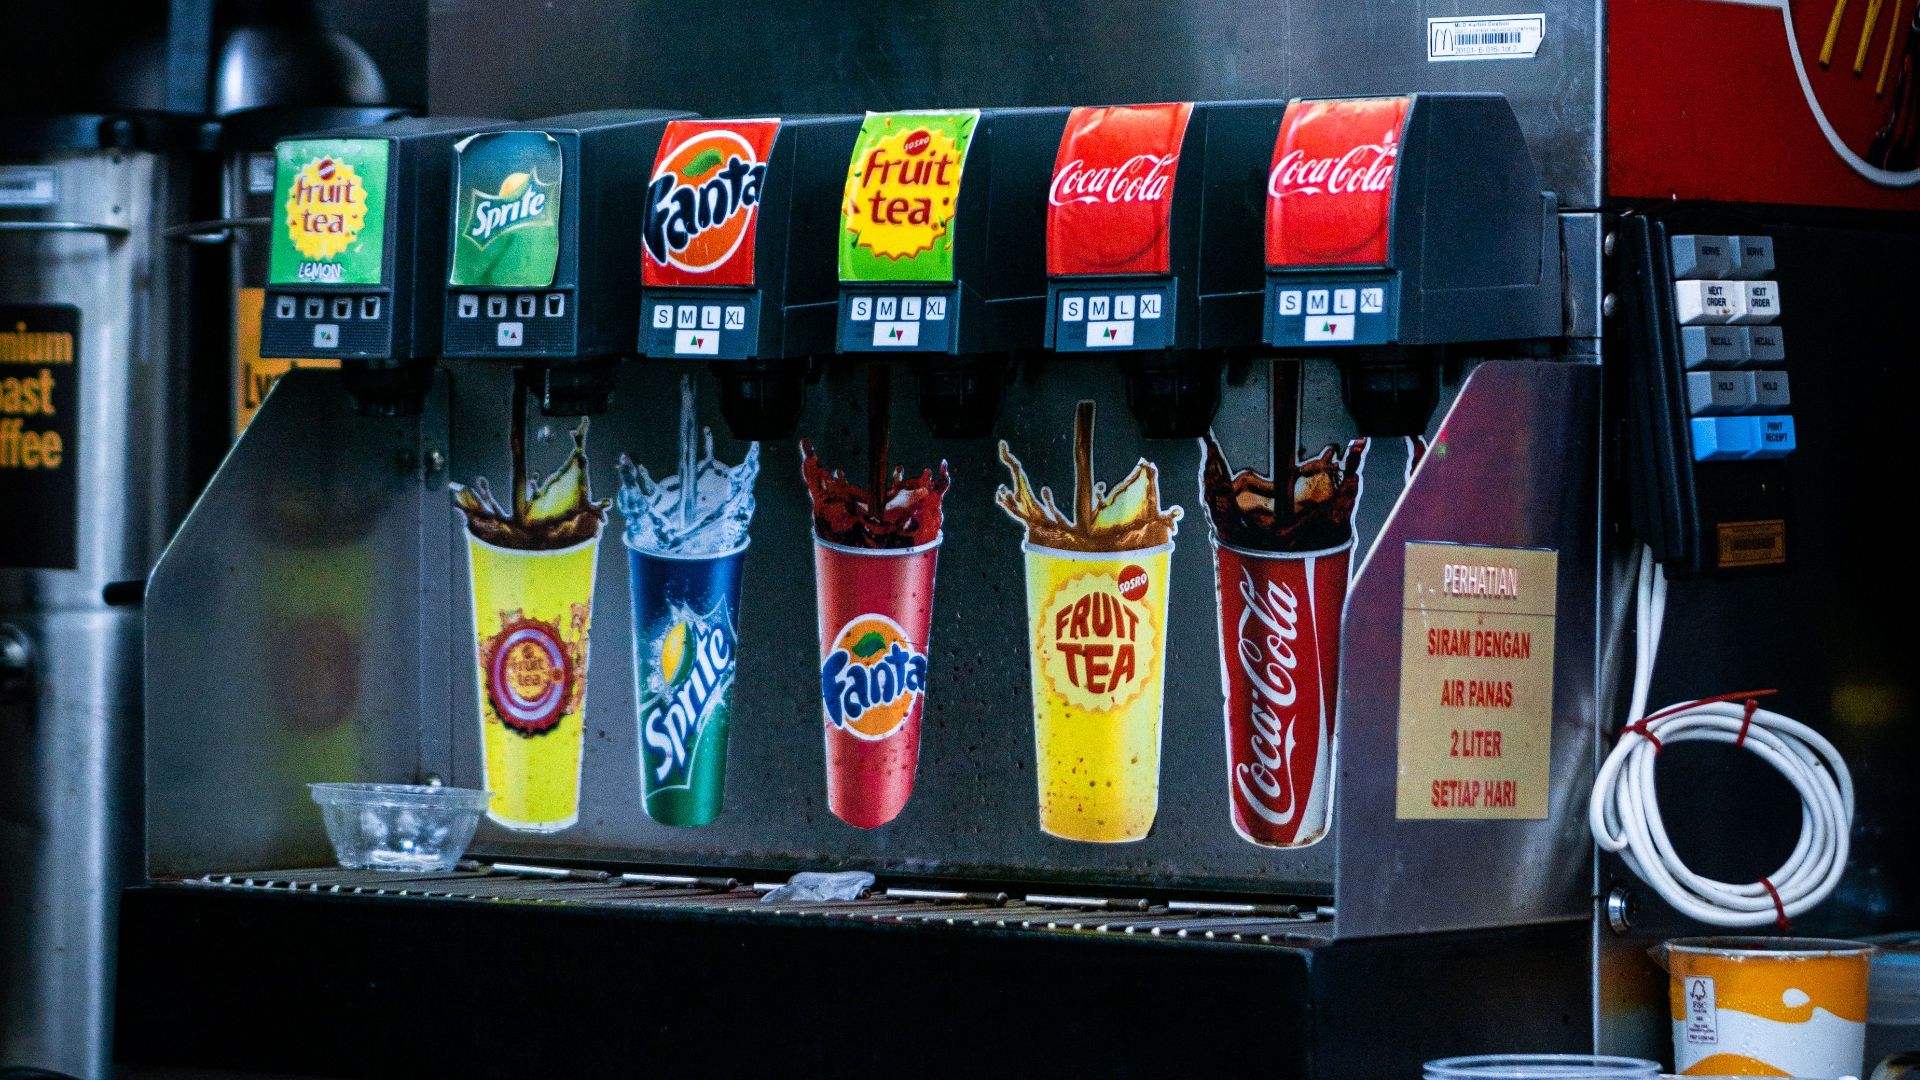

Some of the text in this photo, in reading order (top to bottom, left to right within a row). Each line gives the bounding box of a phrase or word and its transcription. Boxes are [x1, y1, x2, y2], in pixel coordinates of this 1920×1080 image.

[904, 136, 930, 151] SOSRO
[862, 149, 953, 188] fruit
[1049, 153, 1180, 207] Coca-Cola
[1267, 144, 1398, 199] Coca-Cola
[296, 175, 356, 206] fruit
[301, 209, 344, 233] tea
[471, 186, 546, 239] Sprite
[643, 156, 767, 264] Fanta
[868, 190, 933, 226] tea
[298, 261, 342, 281] LEMON
[1285, 292, 1382, 310] S M L XL
[1707, 297, 1726, 306] ORDER
[1708, 286, 1722, 295] NEXT
[1751, 298, 1770, 307] ORDER
[1752, 287, 1766, 296] NEXT
[658, 309, 744, 325] S M L XL
[857, 301, 945, 316] S M L XL
[1067, 299, 1160, 316] S M L XL
[0, 368, 56, 414] ast
[1119, 573, 1148, 593] SOSRO
[1443, 564, 1518, 599] PERHATIAN
[1056, 591, 1139, 642] FRUIT
[1428, 627, 1531, 659] SIRAM DENGAN
[1056, 642, 1136, 695] TEA
[822, 643, 926, 728] Fanta
[1236, 565, 1298, 824] Coca-Cola
[1441, 678, 1513, 708] AIR PANAS
[645, 622, 730, 781] Sprite
[1450, 730, 1502, 758] 2 LITER
[1431, 779, 1517, 808] SETIAP HARI
